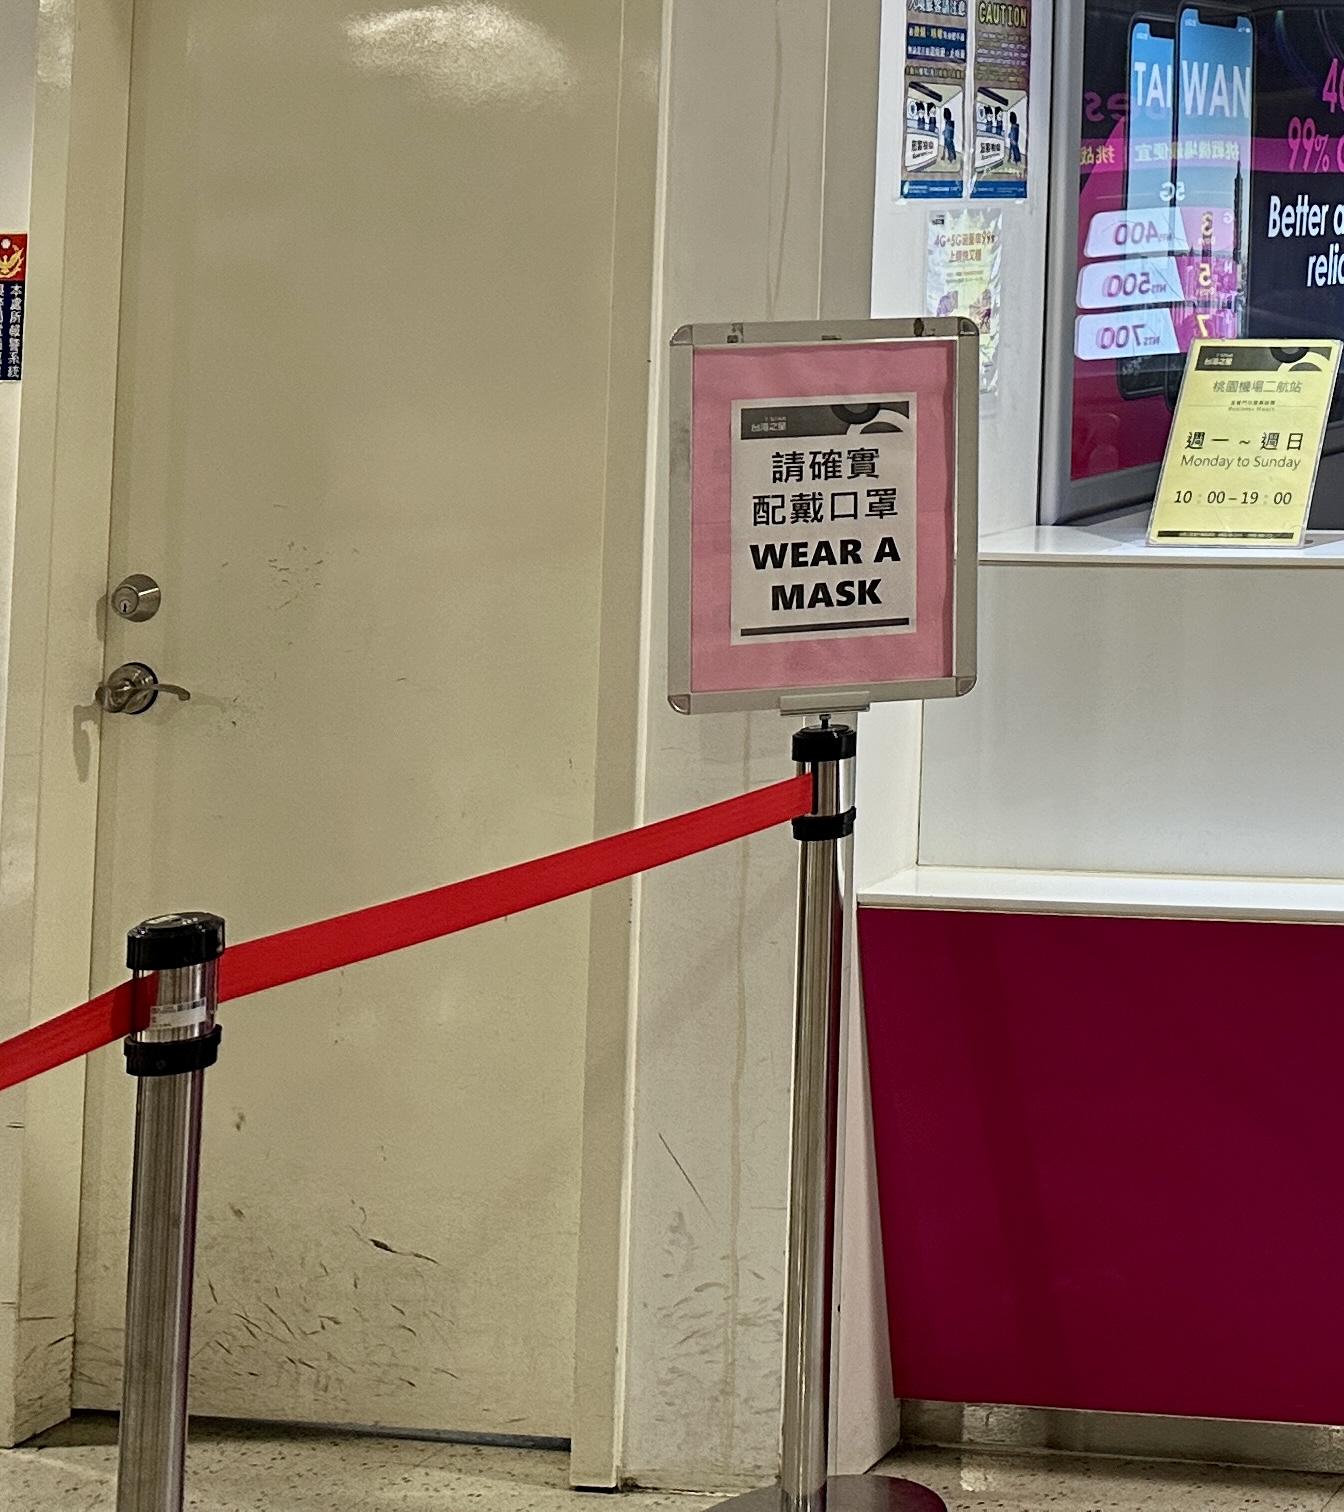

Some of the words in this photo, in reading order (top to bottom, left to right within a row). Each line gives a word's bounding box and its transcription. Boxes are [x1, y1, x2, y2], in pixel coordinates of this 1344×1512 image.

[978, 0, 1028, 28] CAUTION
[1288, 116, 1330, 173] 99%
[1268, 194, 1330, 238] Better
[771, 447, 880, 484] 請確實
[1180, 454, 1234, 470] Monday
[1237, 456, 1250, 467] to
[1253, 455, 1302, 471] Sunday
[752, 487, 898, 526] 配戴口罩
[749, 538, 863, 570] WEAR
[874, 537, 901, 563] A
[771, 579, 882, 611] MASK
